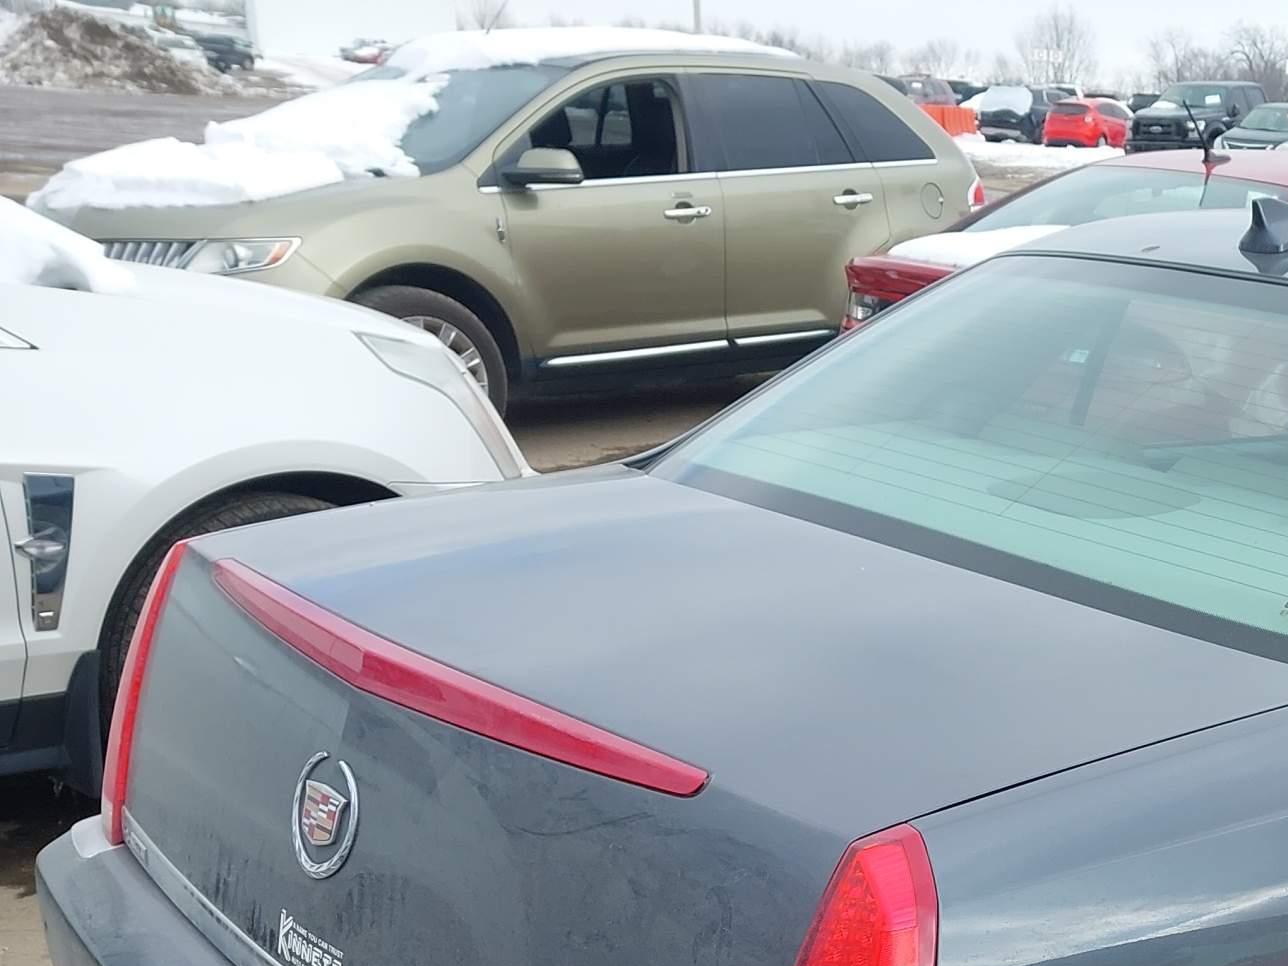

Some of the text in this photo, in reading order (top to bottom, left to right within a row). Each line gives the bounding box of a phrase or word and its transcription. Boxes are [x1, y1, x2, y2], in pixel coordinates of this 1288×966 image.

[308, 933, 318, 943] YOU
[318, 938, 328, 949] CAN
[329, 944, 344, 959] TRUST
